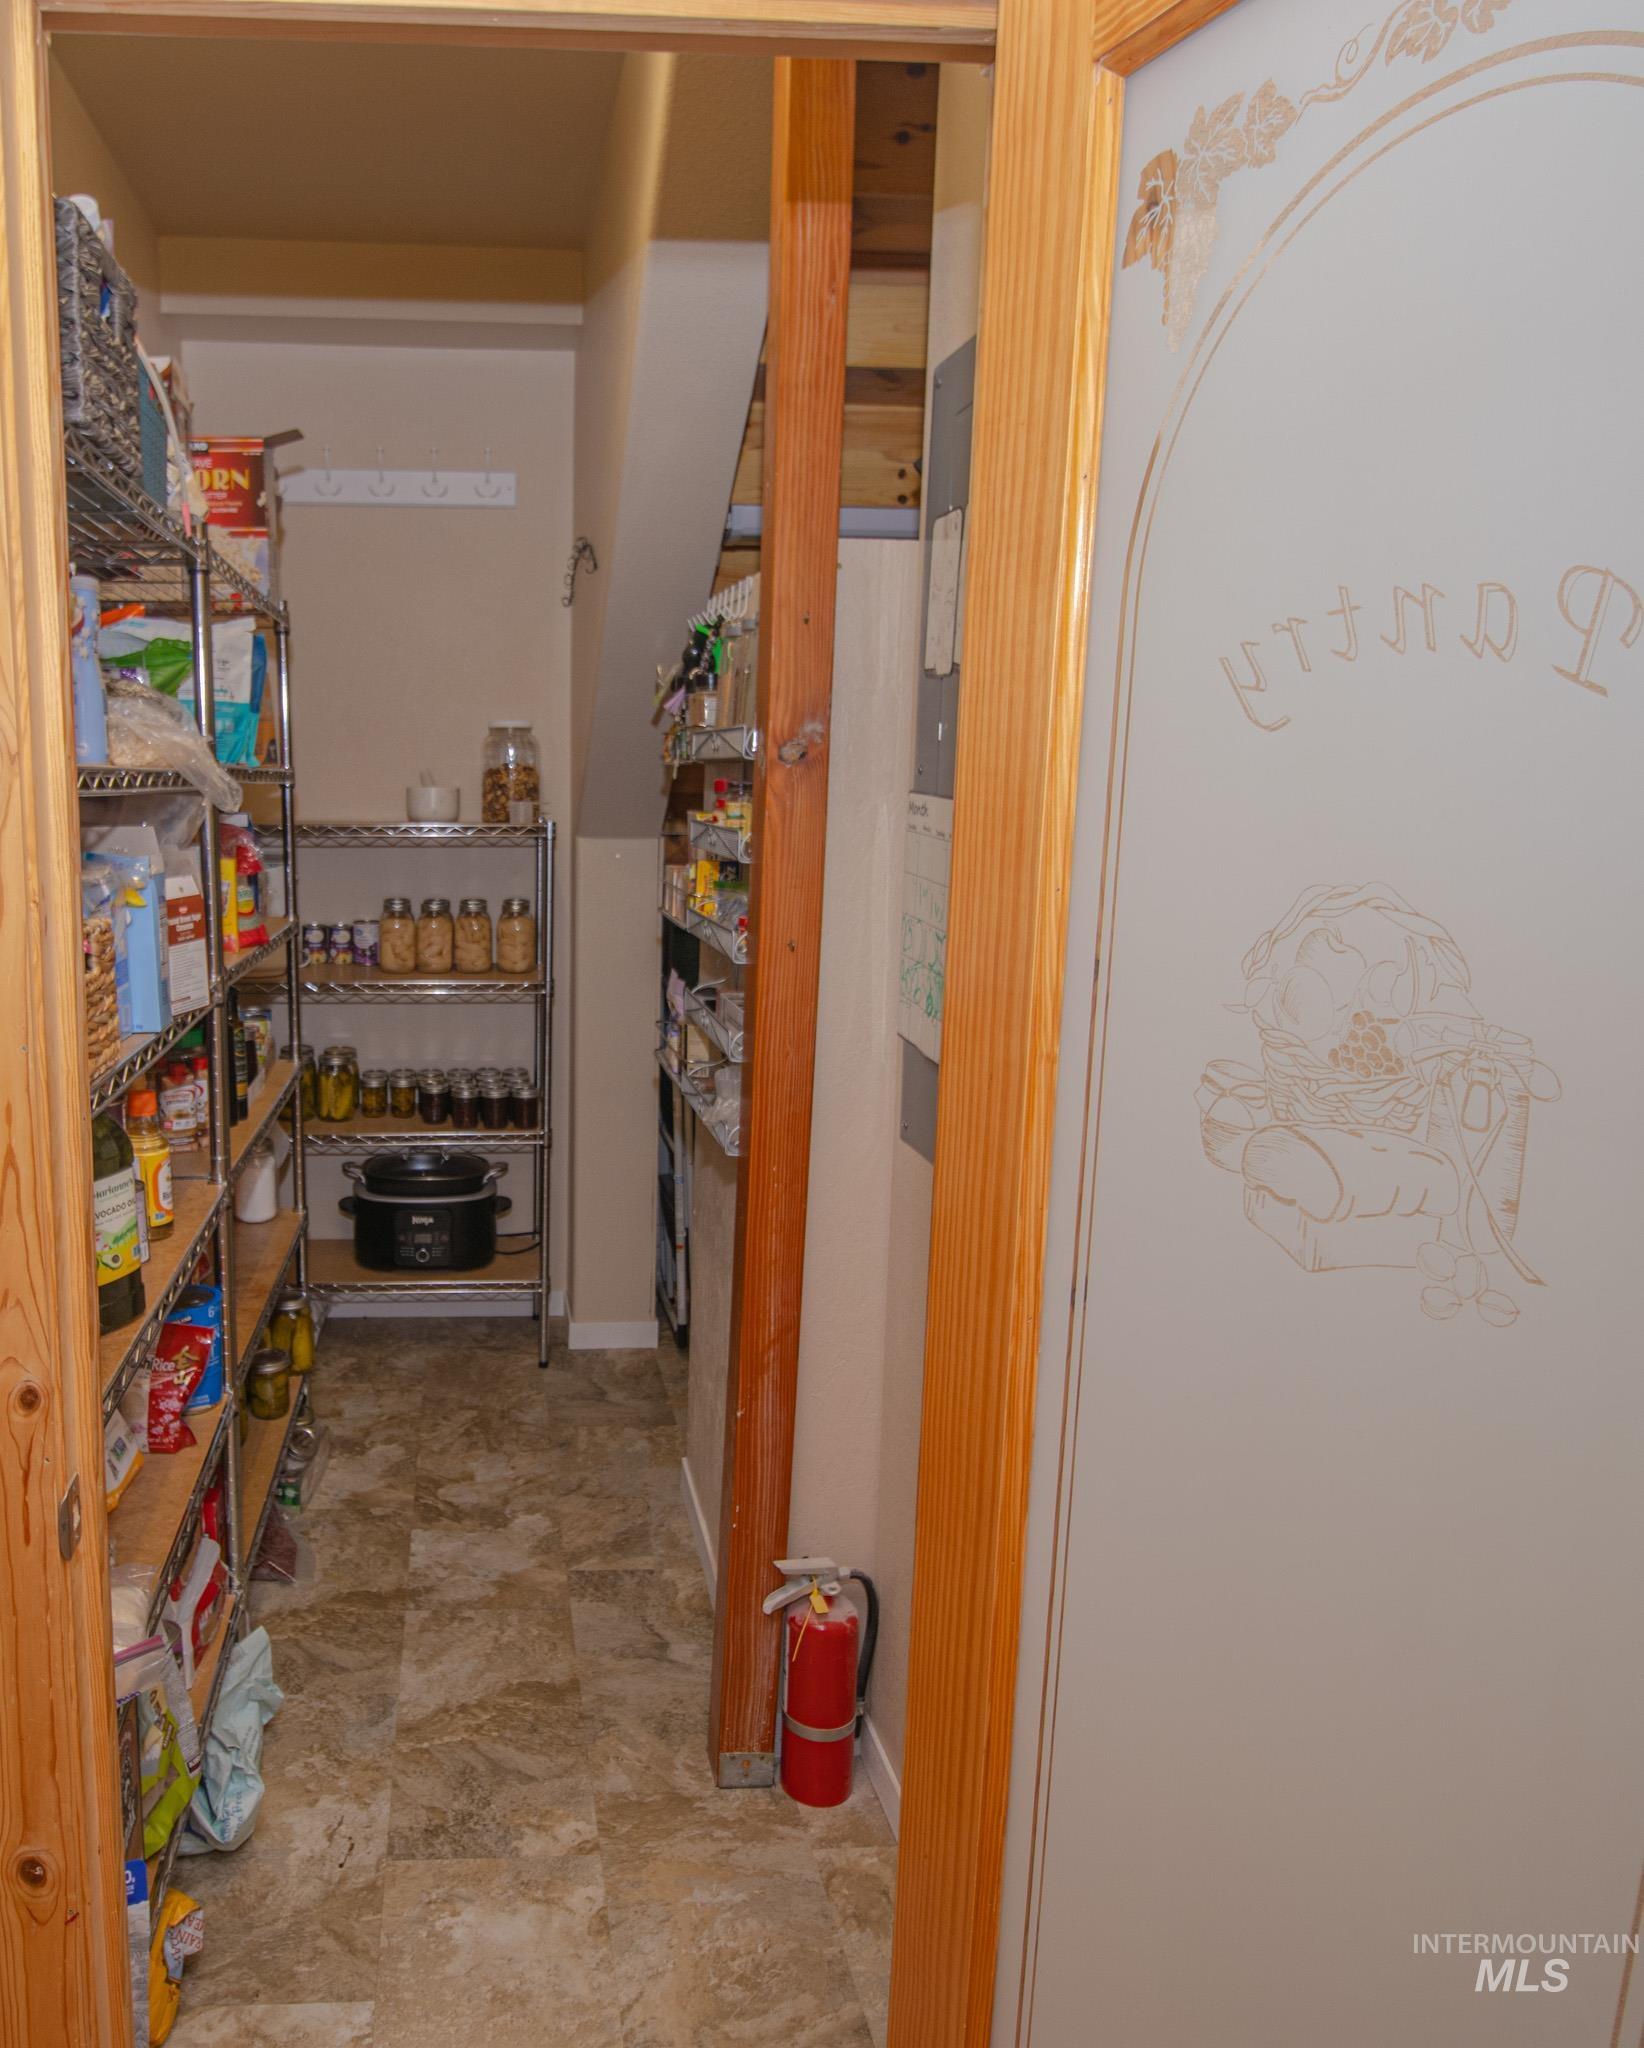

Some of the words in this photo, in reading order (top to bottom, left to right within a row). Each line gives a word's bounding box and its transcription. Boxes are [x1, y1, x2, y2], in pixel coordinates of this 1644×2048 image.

[192, 467, 250, 491] ORN
[94, 1201, 126, 1220] VOCADO
[152, 1357, 176, 1372] Rice
